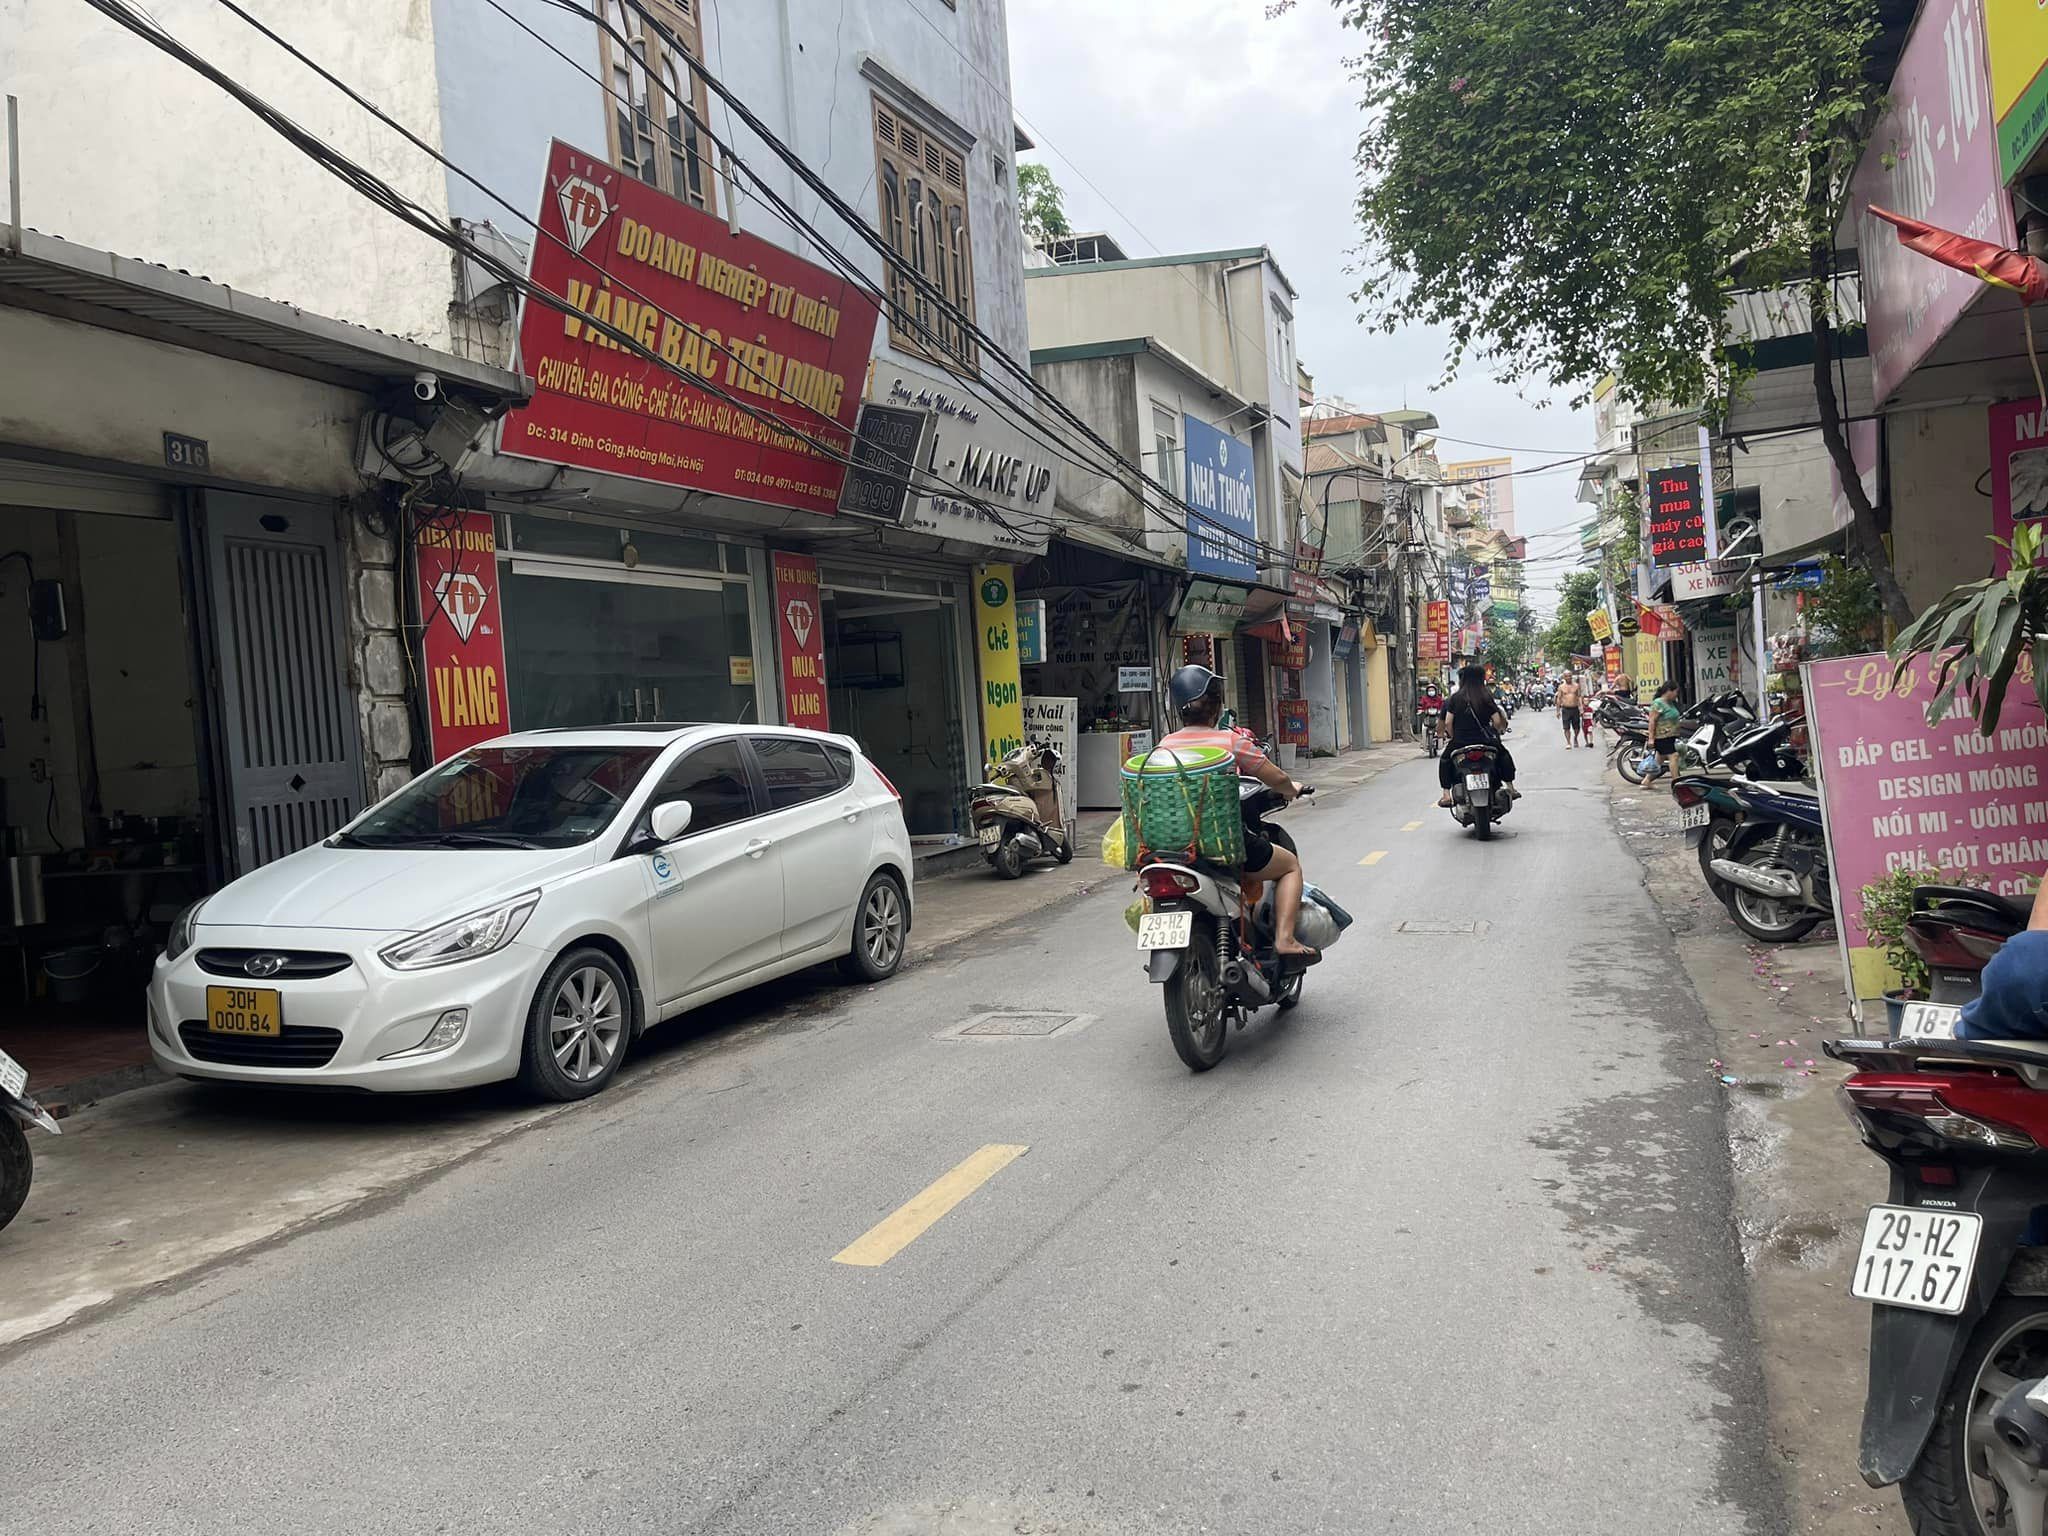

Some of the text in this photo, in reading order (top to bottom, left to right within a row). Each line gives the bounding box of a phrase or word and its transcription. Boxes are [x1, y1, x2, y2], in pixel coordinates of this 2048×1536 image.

[617, 216, 840, 339] DOANH NGHIỆP TƯ NHÂN
[565, 274, 658, 358] VÀNG
[725, 334, 785, 400] TIÊN
[781, 357, 846, 419] DUNG
[171, 440, 206, 468] 316
[527, 422, 546, 438] Đc:
[549, 427, 567, 443] 314
[571, 432, 594, 451] Định
[627, 446, 658, 466] Hoàng
[677, 456, 690, 469] Hà
[690, 459, 705, 475] Nội
[762, 473, 775, 486] 419
[956, 443, 1023, 497] MAKE
[1023, 463, 1051, 504] UP
[1660, 479, 1689, 494] Thu
[1190, 457, 1252, 523] NHÀ THUỐC
[1660, 500, 1691, 513] mua
[1651, 515, 1704, 534] máy cũ
[1653, 536, 1703, 556] giá cao
[444, 581, 481, 615] TD
[1689, 580, 1704, 591] XE
[987, 621, 1009, 652] Chè
[791, 655, 815, 678] MUA
[1707, 646, 1728, 660] XE
[434, 655, 500, 728] VÀNG
[791, 688, 820, 716] VÀNG
[987, 680, 1017, 708] Ngon
[1037, 704, 1064, 720] Nail
[990, 738, 997, 763] 4
[1839, 736, 1883, 768] ĐẮP
[1890, 738, 1932, 763] GEL
[1878, 763, 2038, 801] DESIGN MÓNG
[1872, 807, 1912, 838] NỐI
[1919, 811, 1948, 834] MI
[1969, 798, 2018, 830] UỐN
[1937, 841, 1979, 869] GÓT
[1986, 836, 2048, 866] CHÂN
[1147, 914, 1184, 931] 29-H2
[1141, 931, 1186, 948] 243.89
[226, 991, 258, 1009] 30H
[215, 1010, 271, 1033] 000.84
[1921, 1199, 1957, 1208] HONDA
[1876, 1211, 1962, 1259] 29-H2
[1864, 1254, 1962, 1305] 117.67
